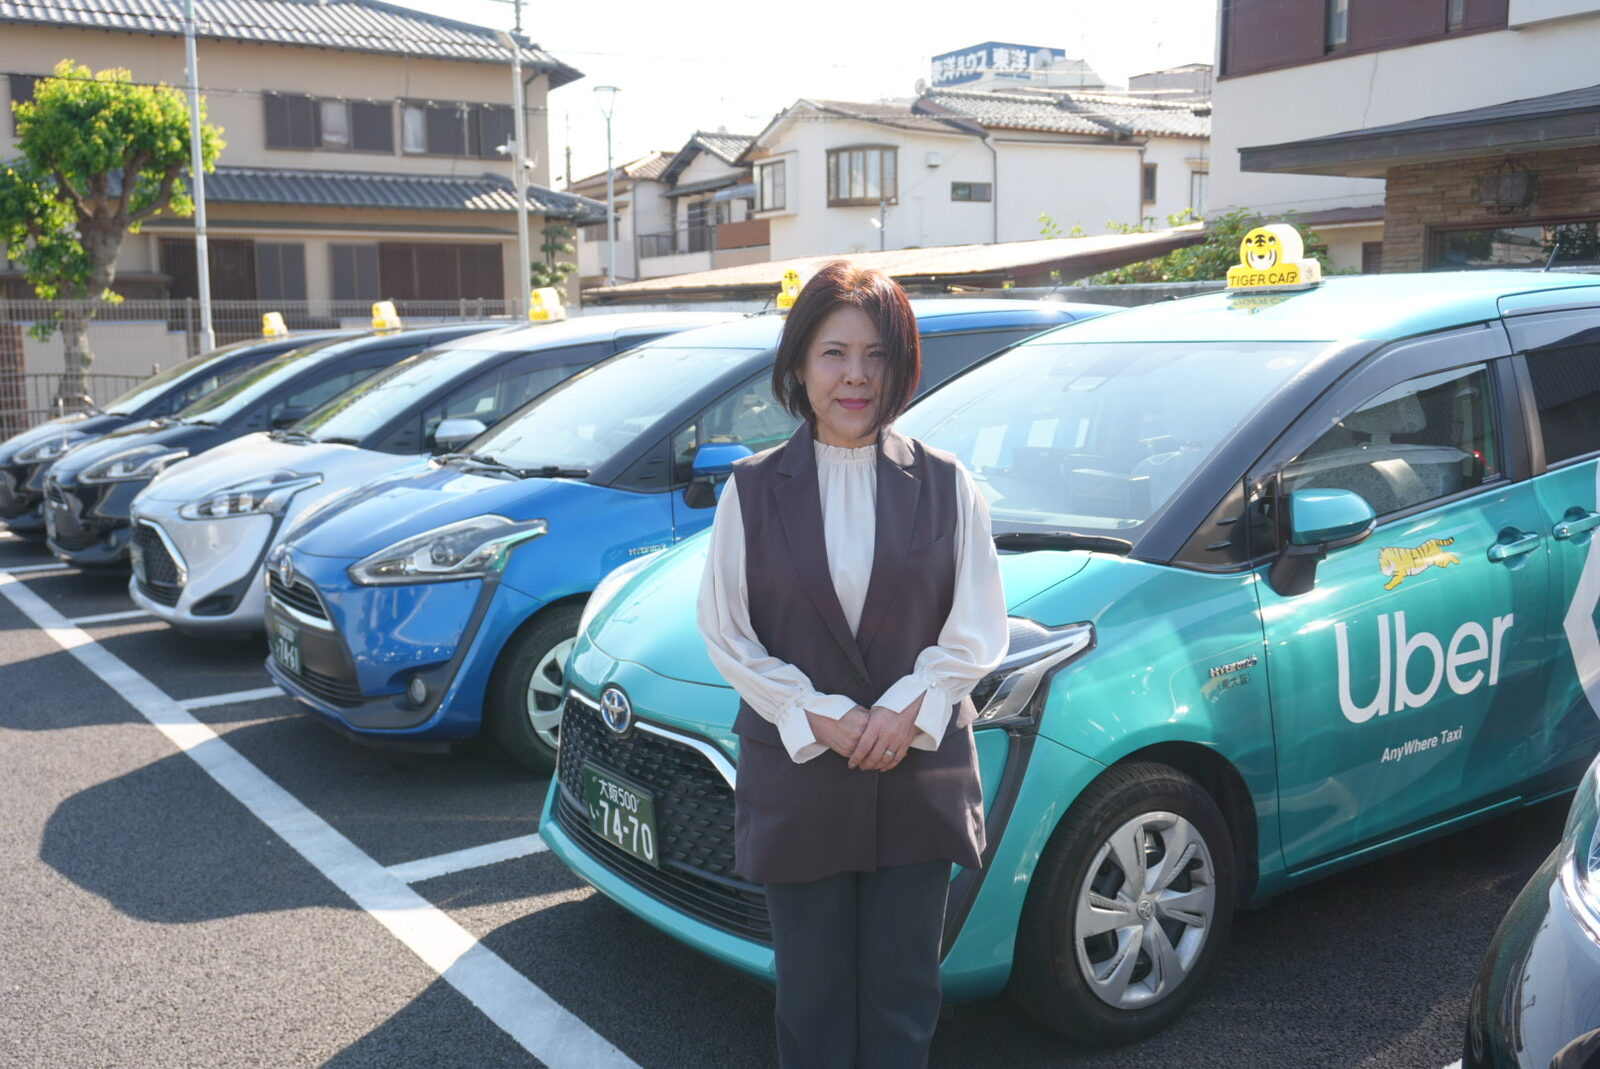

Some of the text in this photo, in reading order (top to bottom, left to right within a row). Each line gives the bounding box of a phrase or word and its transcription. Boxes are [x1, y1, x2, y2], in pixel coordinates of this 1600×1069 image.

[931, 50, 988, 84] 東洋ハウス
[1229, 273, 1266, 287] TIGER
[1268, 271, 1298, 284] CAB
[1334, 610, 1514, 724] Uber
[1380, 726, 1463, 763] AnyWhere Taxi
[589, 799, 654, 860] い 74-70
